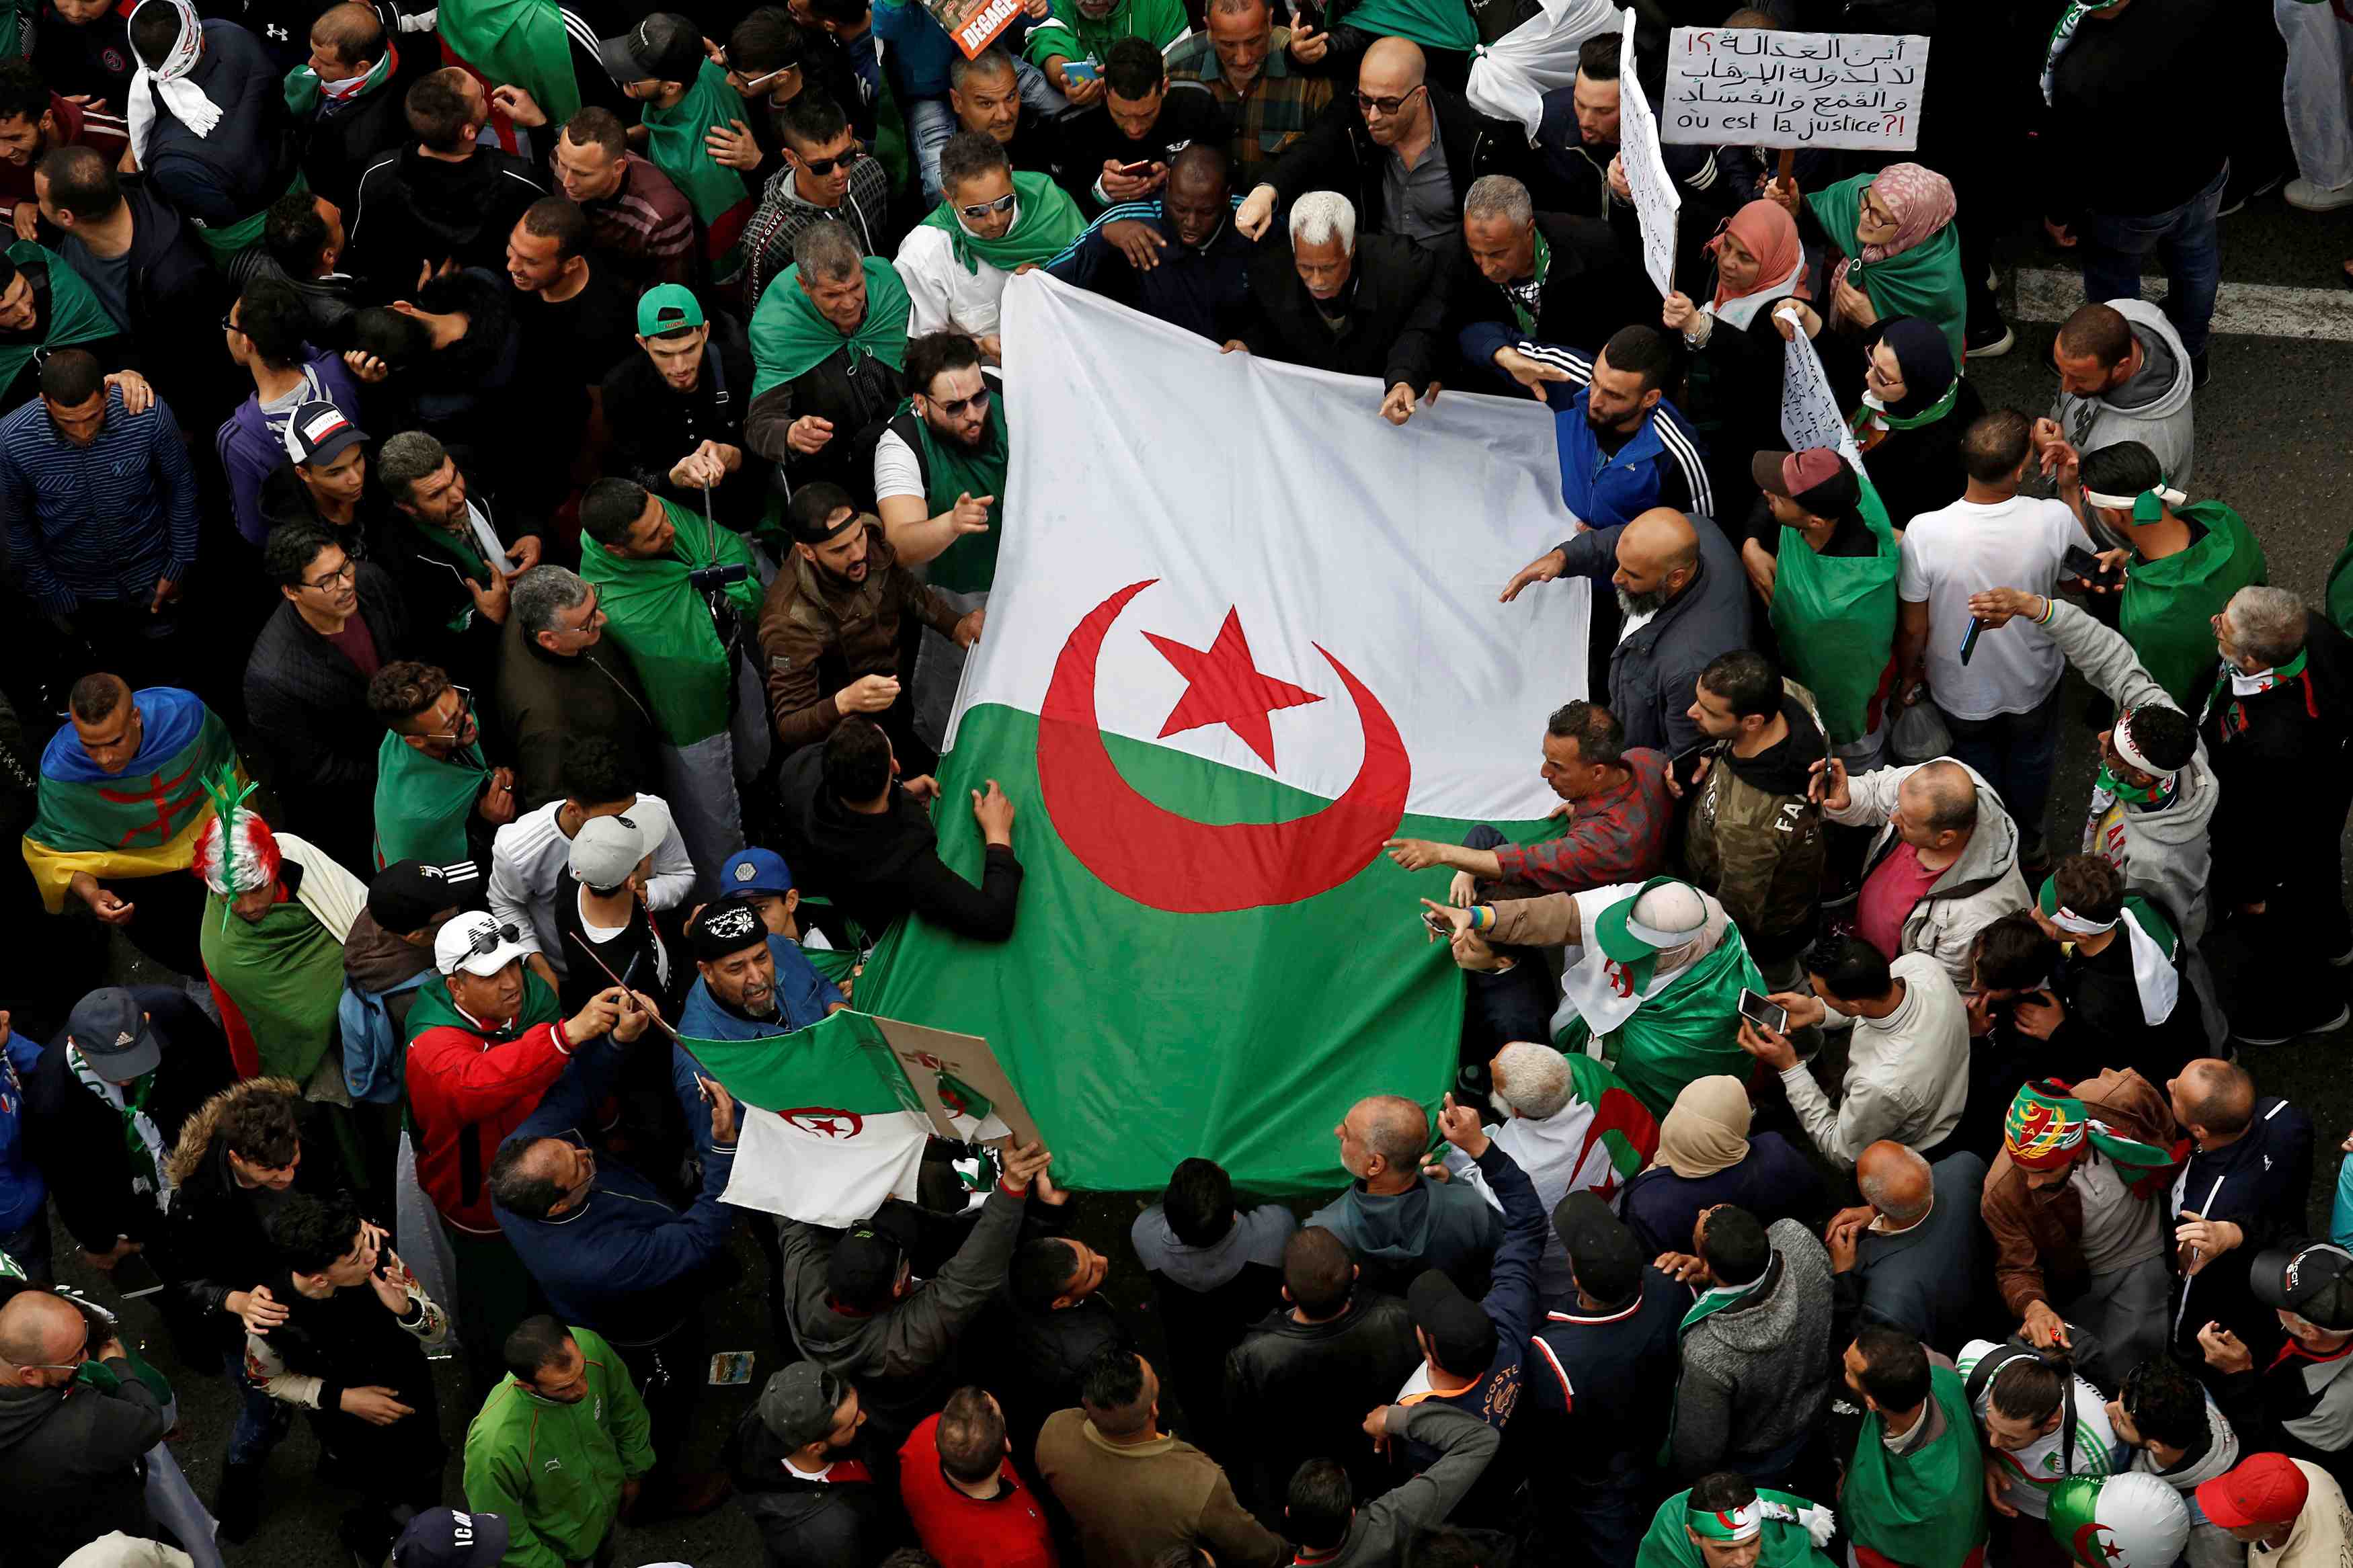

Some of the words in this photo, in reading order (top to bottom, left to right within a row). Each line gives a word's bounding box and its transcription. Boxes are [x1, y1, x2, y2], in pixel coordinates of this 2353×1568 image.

[961, 0, 1018, 50] DEGAGE
[1723, 113, 1756, 129] est
[1773, 114, 1794, 132] la
[2011, 1120, 2035, 1136] MCA
[1482, 1364, 1518, 1423] LACOSTE
